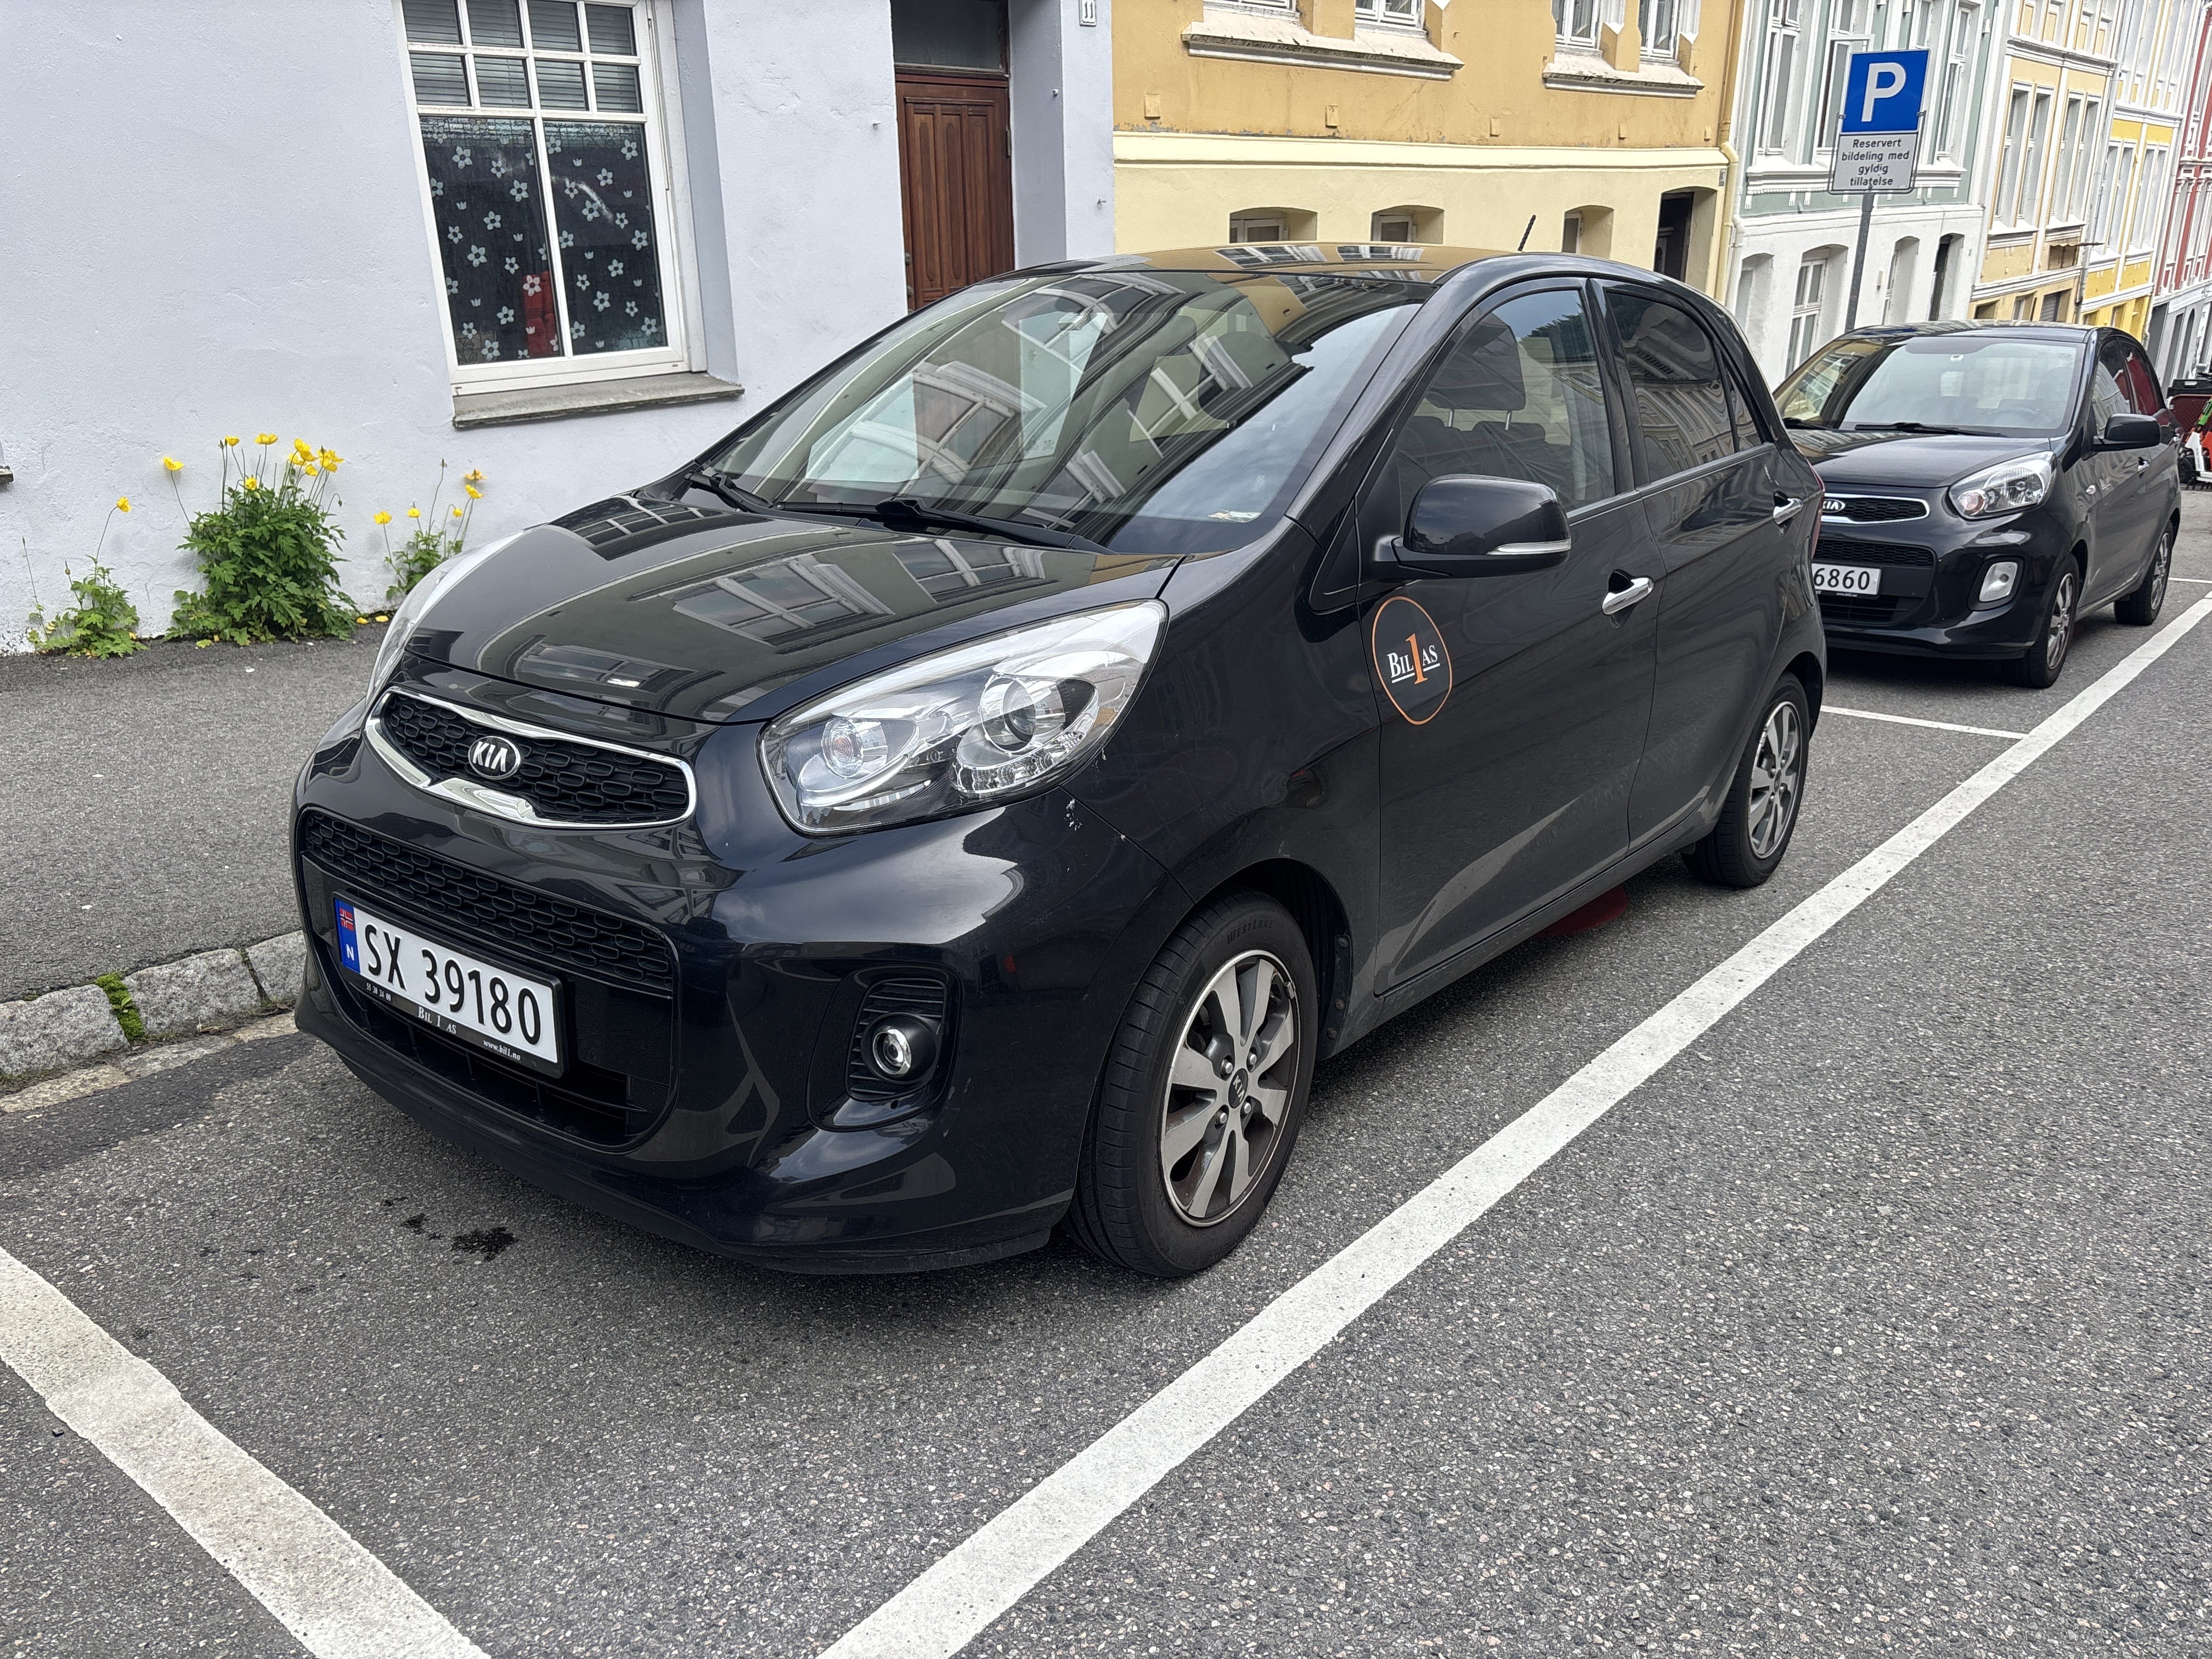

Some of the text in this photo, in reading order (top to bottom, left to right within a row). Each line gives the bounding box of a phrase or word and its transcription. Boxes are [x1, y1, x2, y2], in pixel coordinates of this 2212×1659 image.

[1084, 2, 1093, 19] 11
[1861, 62, 1906, 122] P
[1852, 138, 1902, 149] Reservert
[1841, 150, 1910, 162] bildeling med
[1858, 164, 1888, 175] gyldig
[1850, 176, 1893, 187] tillatelse
[1813, 567, 1870, 590] 6860
[1405, 633, 1428, 685] 1
[1422, 645, 1438, 666] AS
[472, 741, 508, 772] KIA
[346, 944, 355, 962] N
[365, 923, 541, 1045] SX 39180
[436, 1015, 441, 1028] 1
[446, 1023, 458, 1034] AS
[483, 1040, 521, 1061] www.bil1.no
[1233, 1074, 1245, 1103] KIA
